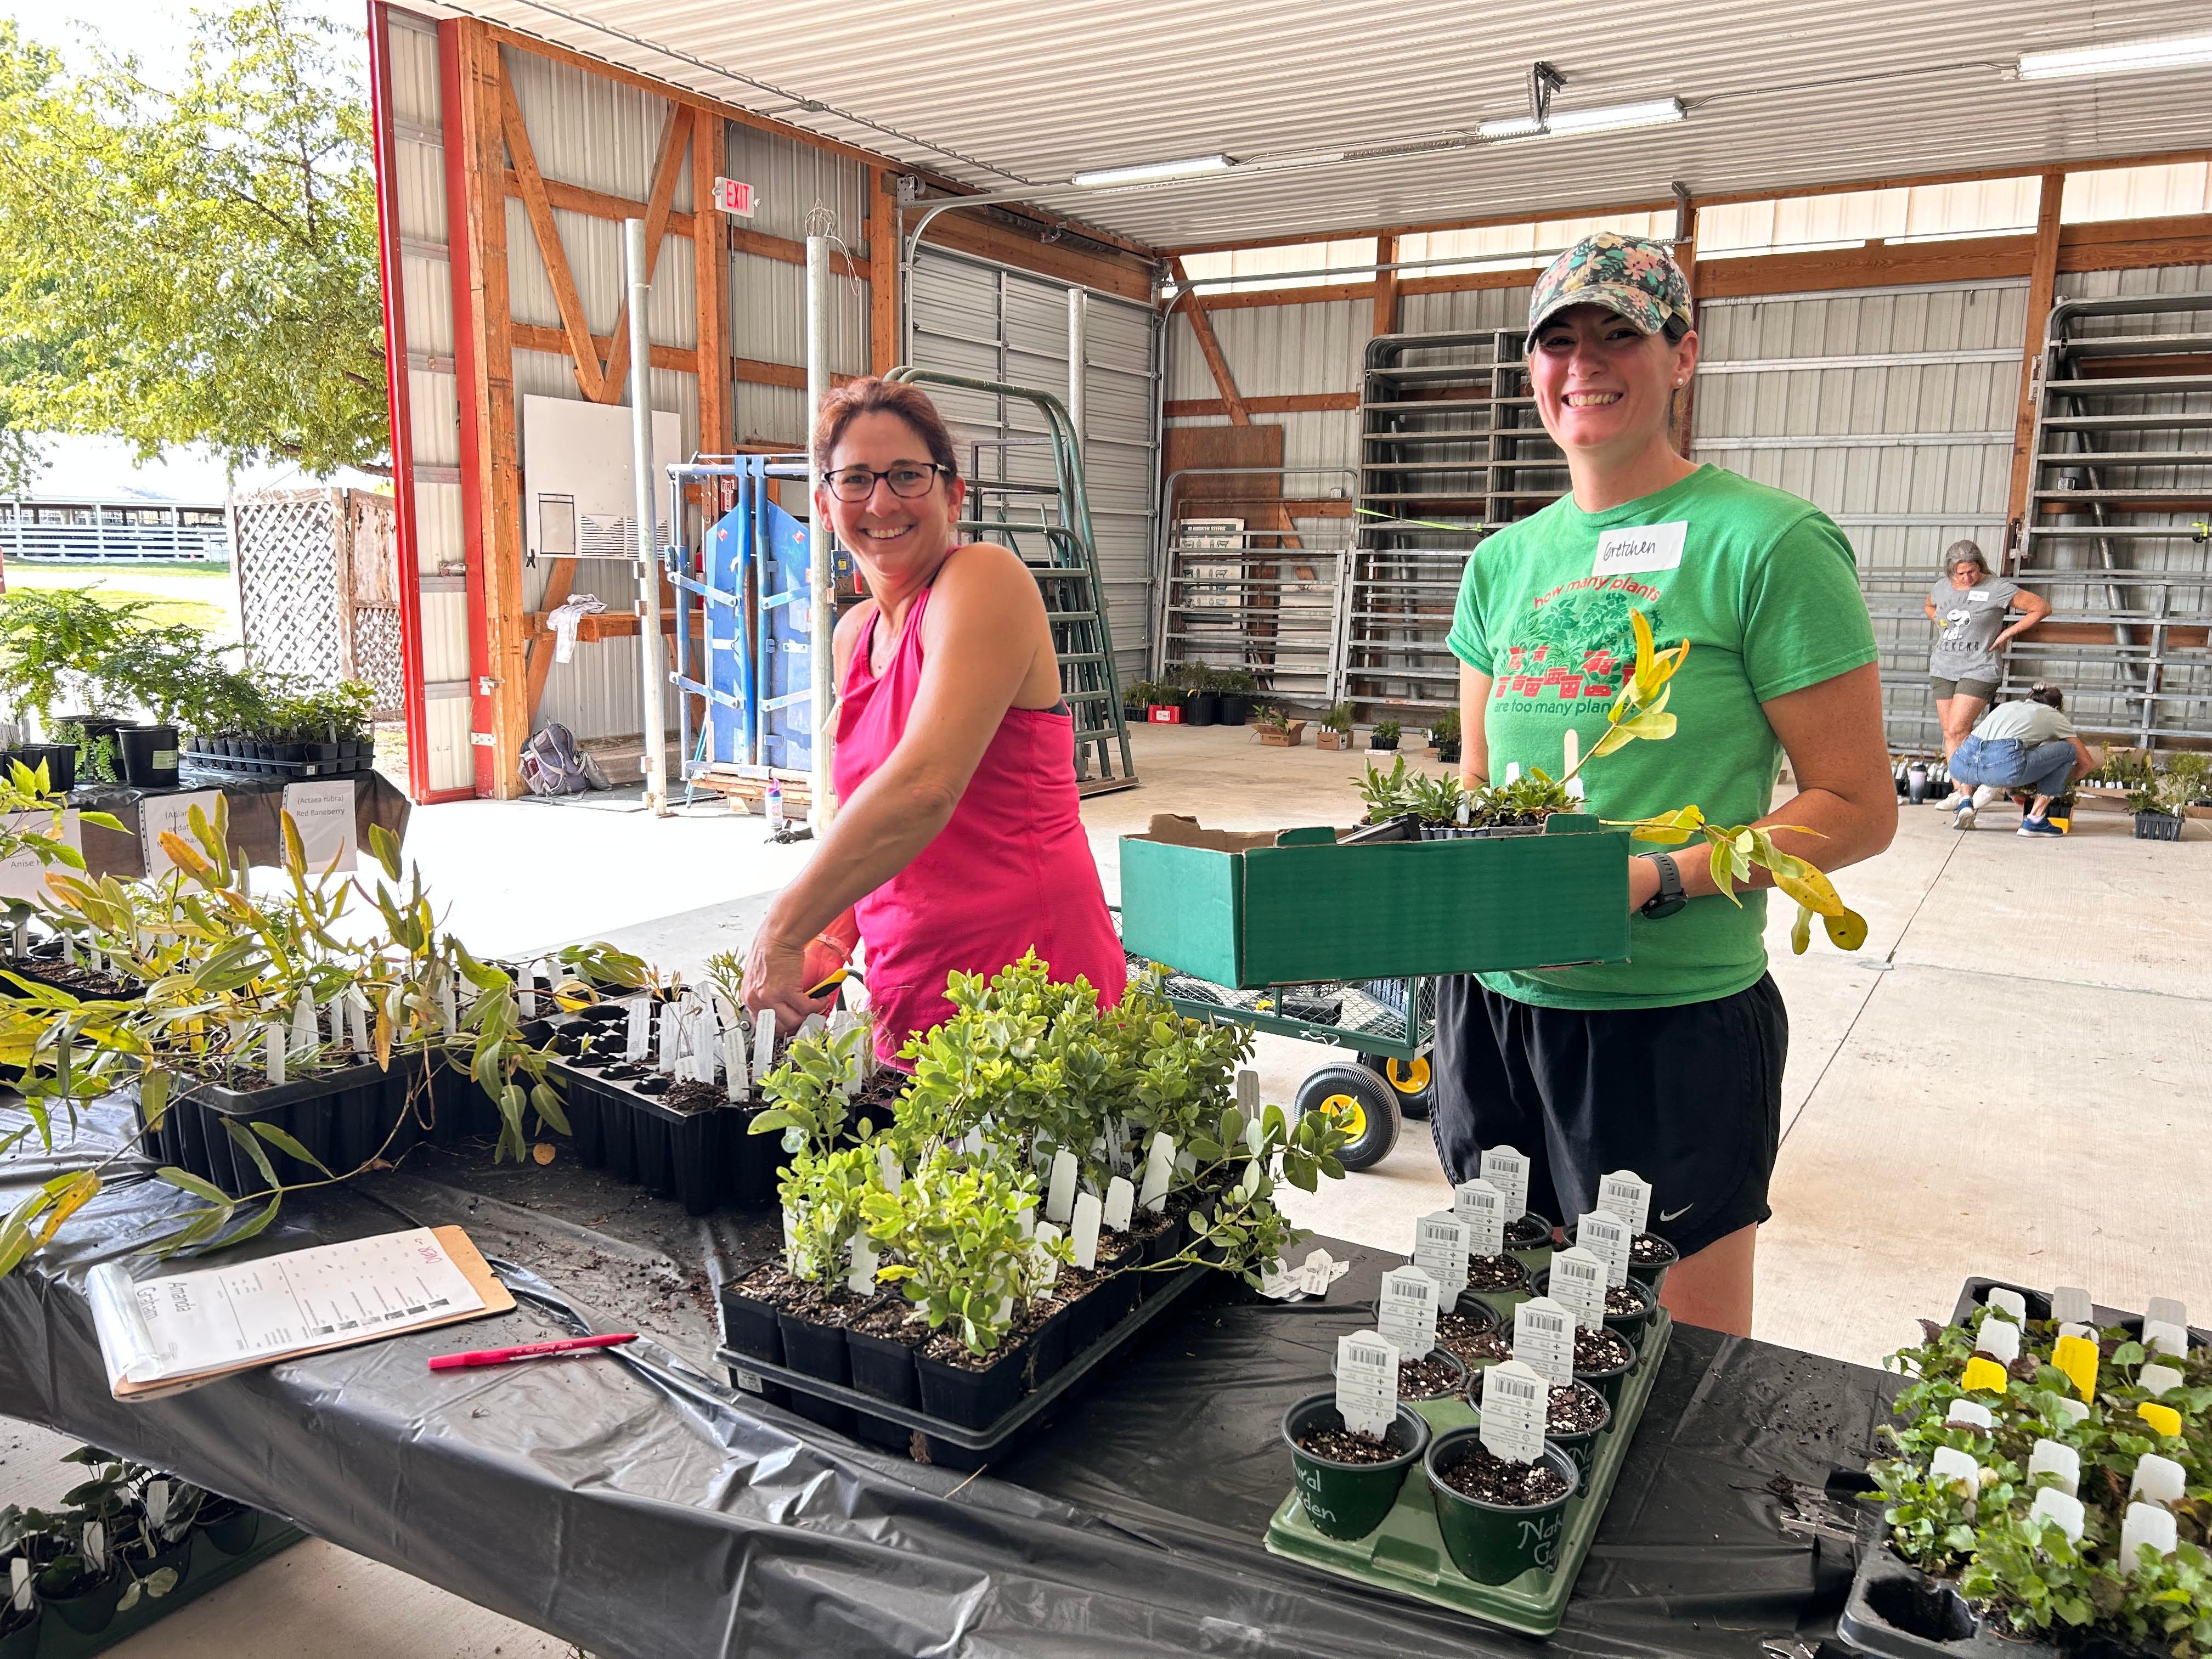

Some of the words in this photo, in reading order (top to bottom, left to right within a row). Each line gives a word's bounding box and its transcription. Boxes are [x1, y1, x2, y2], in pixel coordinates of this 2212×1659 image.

[726, 180, 749, 211] EXIT
[1603, 539, 1655, 561] Gretchen
[1534, 585, 1564, 609] how
[1566, 577, 1610, 591] many
[1607, 576, 1661, 601] plants
[1494, 702, 1509, 713] are
[1511, 699, 1533, 713] too
[1536, 702, 1573, 716] many
[10, 859, 34, 868] Anise
[167, 1282, 196, 1312] Amanda
